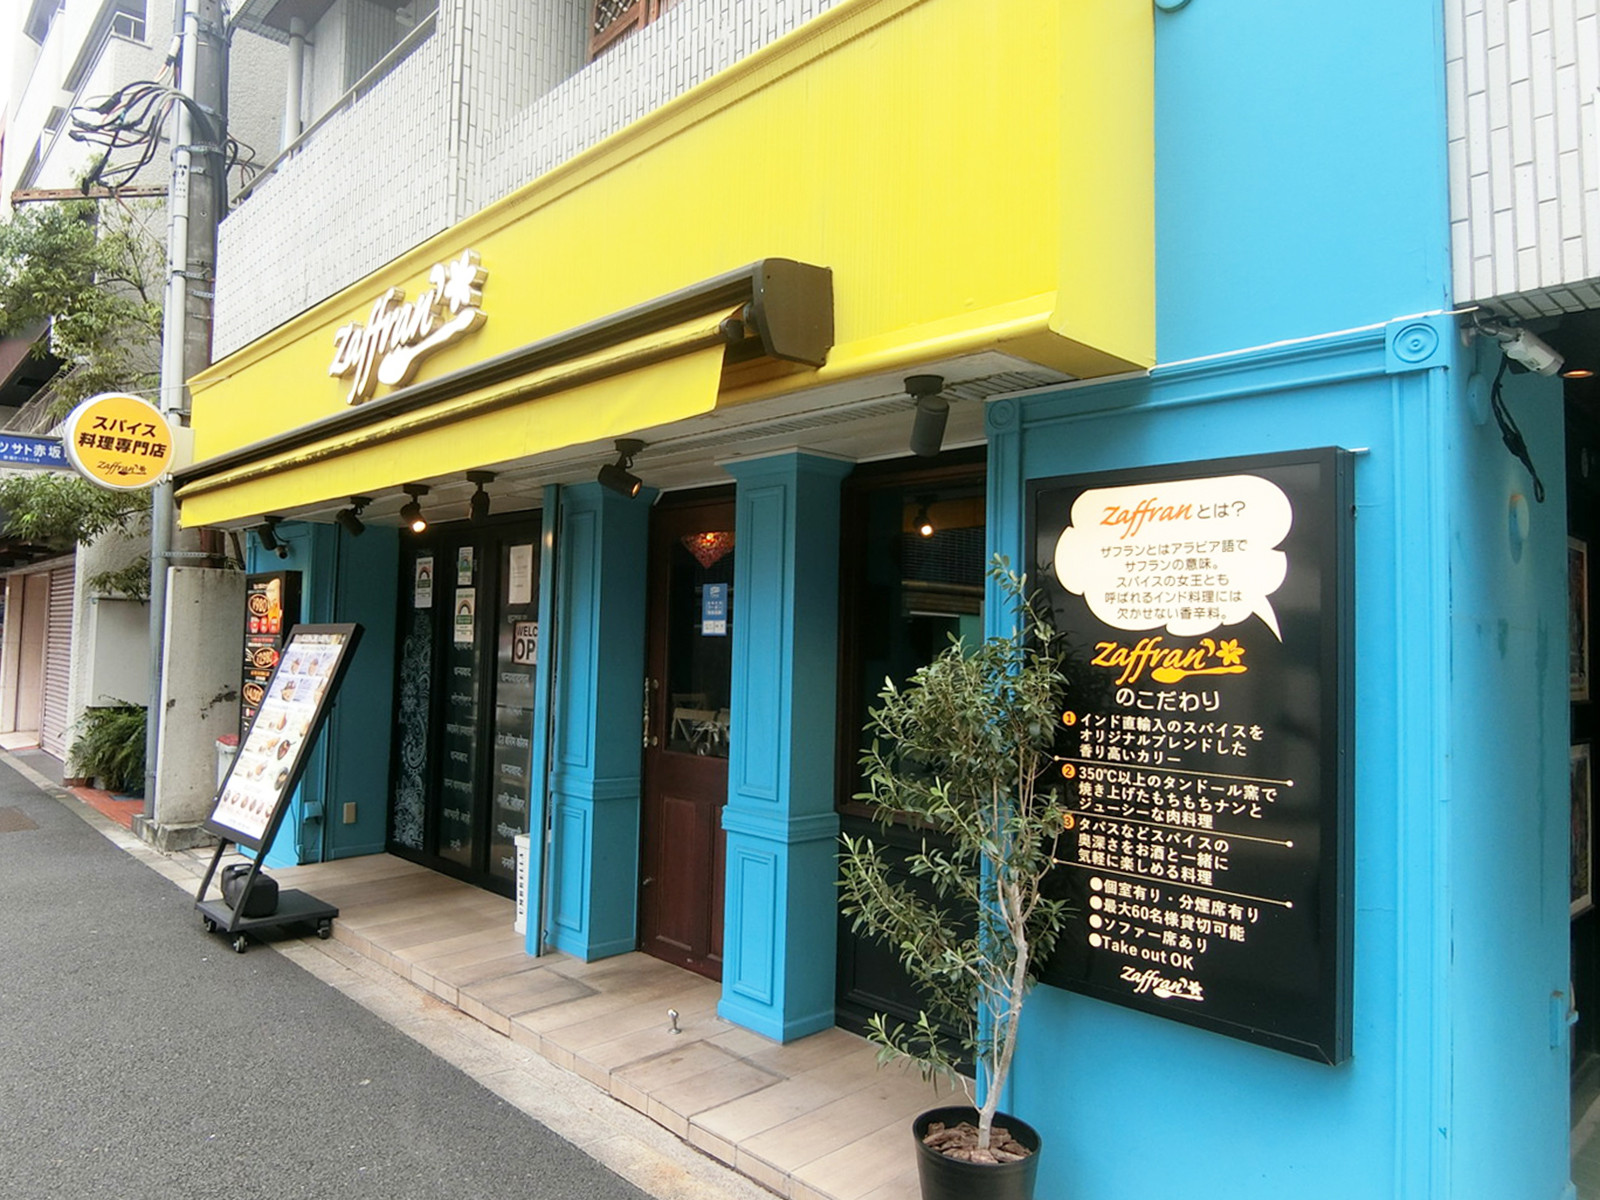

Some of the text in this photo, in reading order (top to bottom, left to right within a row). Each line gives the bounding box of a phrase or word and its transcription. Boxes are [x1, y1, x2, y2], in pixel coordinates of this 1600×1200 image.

[93, 416, 157, 438] スパイス
[79, 432, 167, 458] 料理専門店
[1197, 501, 1246, 520] とは？
[1100, 540, 1248, 558] ザフランとはアラビア語で
[1125, 557, 1219, 573] サフランの意味。
[1117, 574, 1229, 588] スパイスの女王とも
[1105, 590, 1242, 605] 呼ばれるインド料理には
[1117, 607, 1228, 621] 欠かせない香辛料。
[1116, 688, 1219, 712] のこだわり
[1081, 712, 1263, 740] インド直輸入のスパイスを
[1080, 729, 1247, 756] オリジナルブレンドした
[1080, 744, 1181, 764] 香り高いカリー
[1079, 781, 1262, 818] 焼き上げたもちもちナンと
[1079, 800, 1213, 829] ジューシーな肉料理
[1079, 818, 1229, 852] タパスなどスパイスの
[1079, 834, 1228, 870] 奥深さをお酒と一緒に
[1078, 848, 1213, 886] 気軽に楽しめる料理
[1104, 918, 1207, 953] ソファー席あり
[1104, 935, 1194, 970] Take out OK
